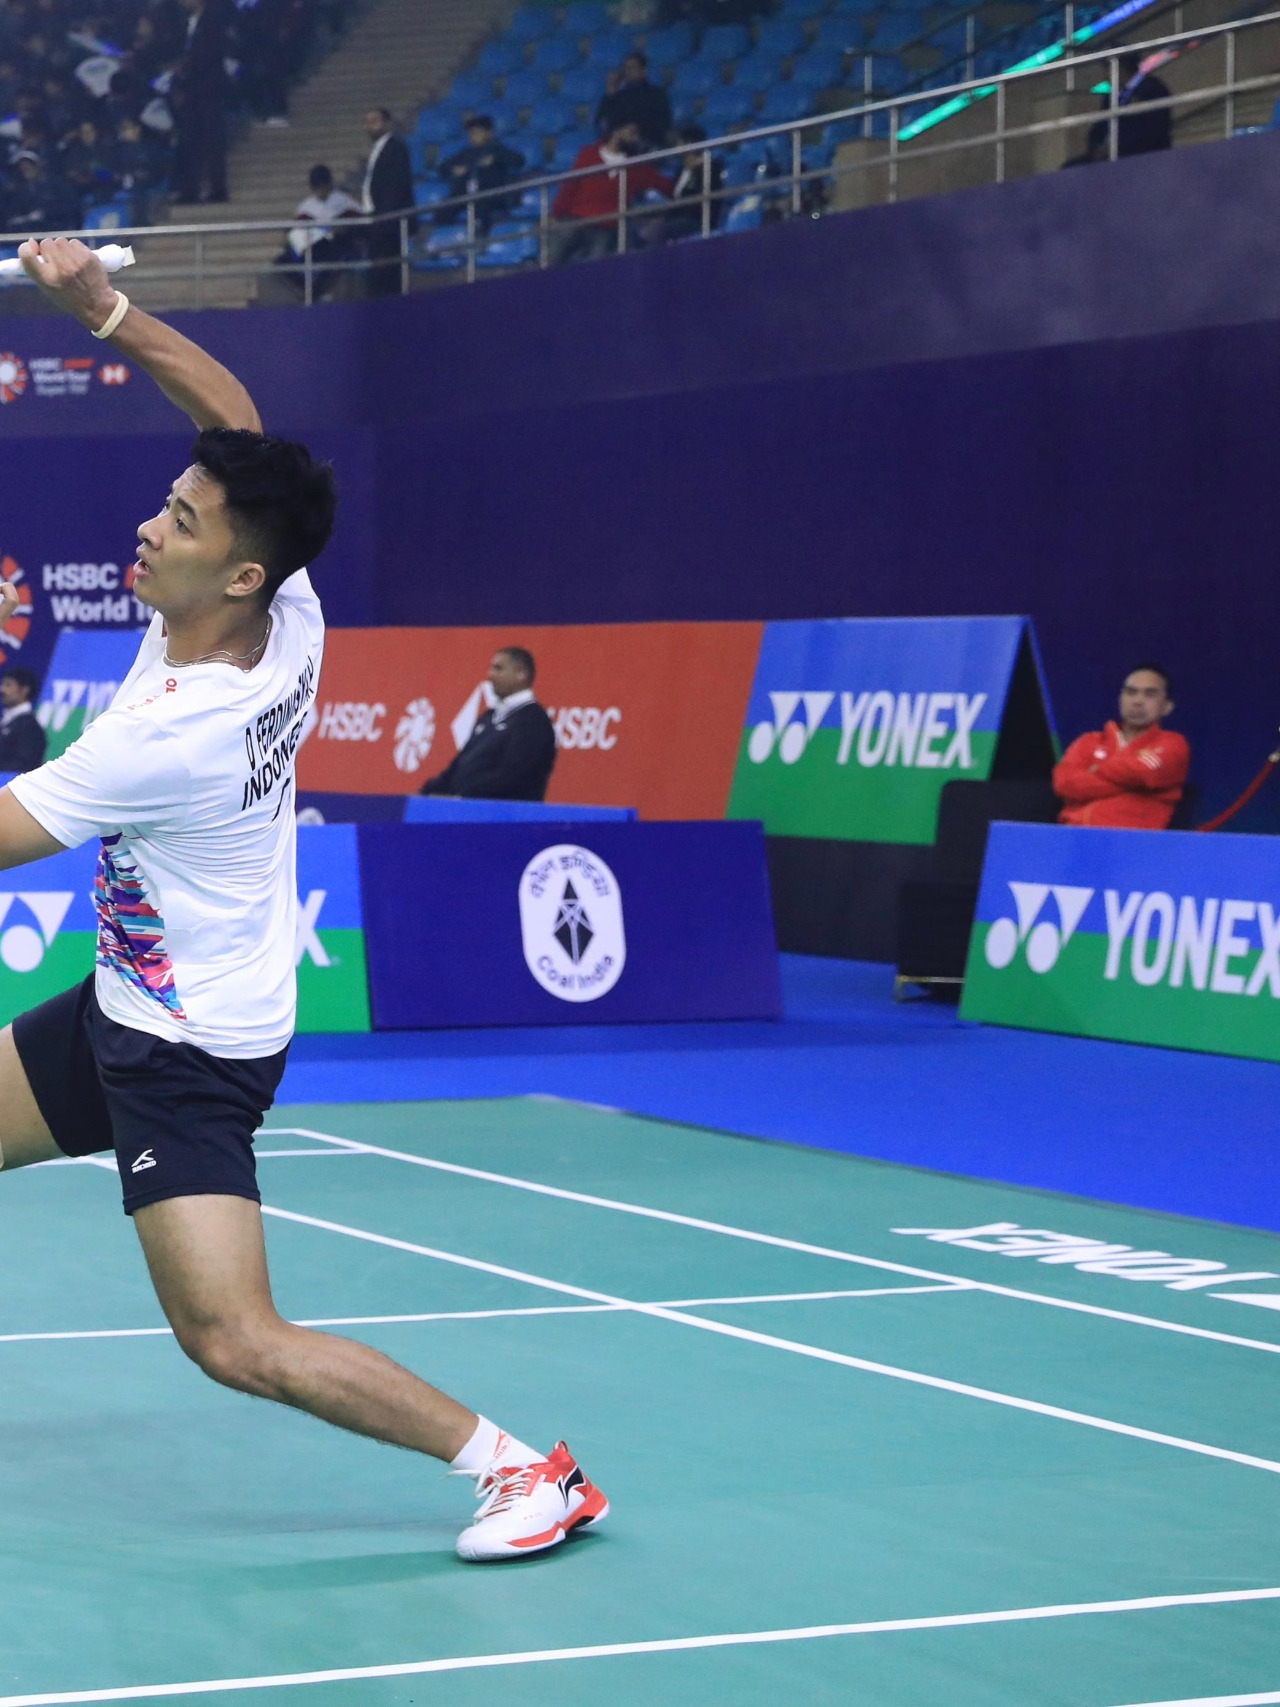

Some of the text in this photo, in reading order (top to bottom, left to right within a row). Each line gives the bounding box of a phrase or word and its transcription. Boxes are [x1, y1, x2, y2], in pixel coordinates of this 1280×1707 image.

[43, 563, 119, 591] HSBC
[51, 596, 129, 622] World
[319, 702, 386, 741] HSBC
[837, 690, 989, 768] YONEX
[538, 956, 613, 988] Coal India
[889, 1222, 1280, 1291] YONEX
